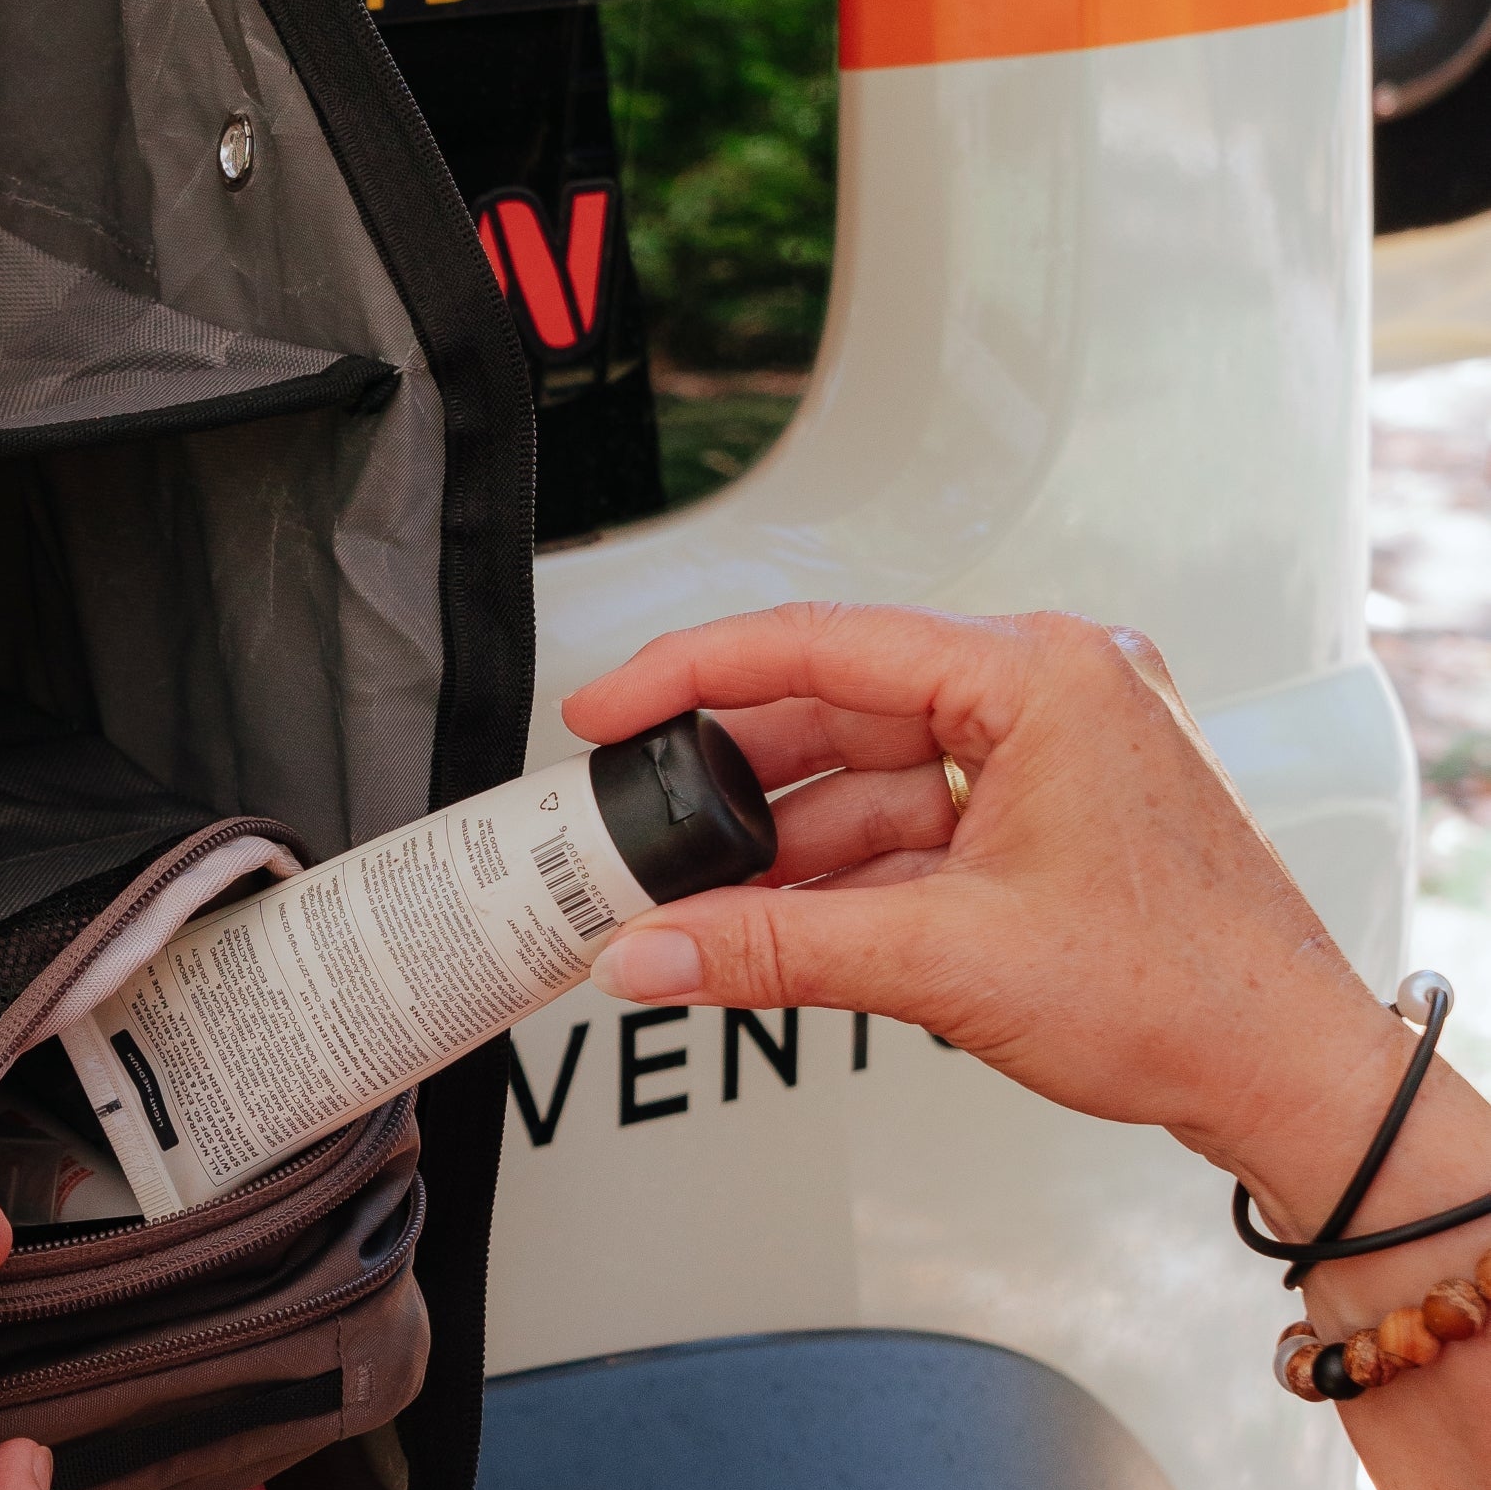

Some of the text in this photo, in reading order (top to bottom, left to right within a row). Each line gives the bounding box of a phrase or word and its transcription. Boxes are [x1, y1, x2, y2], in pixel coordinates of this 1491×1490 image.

[459, 817, 472, 853] WESTERN
[478, 828, 501, 881] DISTRIBUTED
[484, 817, 509, 878] AVOCADO ZINC
[470, 863, 486, 889] MADE
[472, 839, 493, 886] AUSTRALIA
[565, 841, 590, 880] 82300
[586, 883, 616, 916] 94536
[505, 917, 558, 982] KELSALL CRESCENT
[514, 947, 532, 966] ZINC
[522, 928, 538, 946] 6152
[174, 953, 191, 986] BROAD
[217, 944, 240, 986] NATURAL
[150, 978, 169, 1010] MADE
[194, 982, 221, 1028] RESISTANT
[234, 985, 250, 1008] 100%
[305, 976, 323, 1003] Oxide
[317, 1001, 333, 1021] Zinc
[129, 1000, 169, 1069] MOISTURISER
[133, 987, 169, 1047] COVERAGE,
[164, 1010, 183, 1039] SKIN.
[189, 991, 221, 1049] MOISTURISER
[208, 945, 310, 1130] BREASTFEEDING SAFE DEEPLY MOISTURISING
[217, 990, 248, 1043] PREGNANCY
[222, 927, 326, 1121] NATURALLY DERIVED INGREDIENTS FRAGRANCE
[231, 927, 335, 1117] FREE PRESERVATIVE FREE CHEMICAL ACTIVES
[239, 922, 343, 1112] FREE GLUTEN FREE NUT FREE ECO FRIENDLY
[247, 1011, 261, 1030] USE
[407, 1004, 451, 1053] DIRECTIONS
[149, 998, 192, 1080] BLEND-ABILITY.
[175, 1010, 211, 1072] AUSTRALIA.
[190, 945, 294, 1139] WHITE CAST REEF FRIENDLY VEGAN CRUELTY
[216, 1027, 237, 1060] WATER
[256, 1028, 284, 1075] EVERYDAY
[275, 987, 351, 1108] PCR TUBES 100% RECYCLABLE
[298, 989, 370, 1097] FULL INGREDIENTS LIST
[327, 996, 391, 1086] Non-Active Ingredients:
[328, 1021, 364, 1070] Ingredients:
[164, 1047, 196, 1106] EXCELLENT
[178, 1038, 209, 1092] SENSITIVE
[216, 1047, 236, 1079] TINTED
[231, 1058, 252, 1090] HOURS
[245, 1046, 271, 1089] FRIENDLY
[279, 1074, 295, 1093] FOR
[358, 1068, 381, 1092] Active
[125, 1051, 164, 1128] LIGHT-MEDIUM
[164, 1069, 186, 1108] TINTED
[204, 1092, 221, 1115] FOR
[205, 1071, 237, 1122] WESTERN
[231, 1078, 258, 1119] NATURAL
[266, 1088, 284, 1112] BABY
[290, 1092, 319, 1126] PERFECT
[181, 1107, 211, 1157] NATURAL
[193, 1090, 241, 1168] SPREADABILITY
[199, 1124, 215, 1144] SPF
[216, 1115, 250, 1163] SUITABLE
[253, 1100, 286, 1144] SPECTRUM
[262, 1132, 278, 1148] SPF
[282, 1114, 302, 1134] FREE
[206, 1157, 223, 1178] ALL
[210, 1144, 232, 1173] WITH
